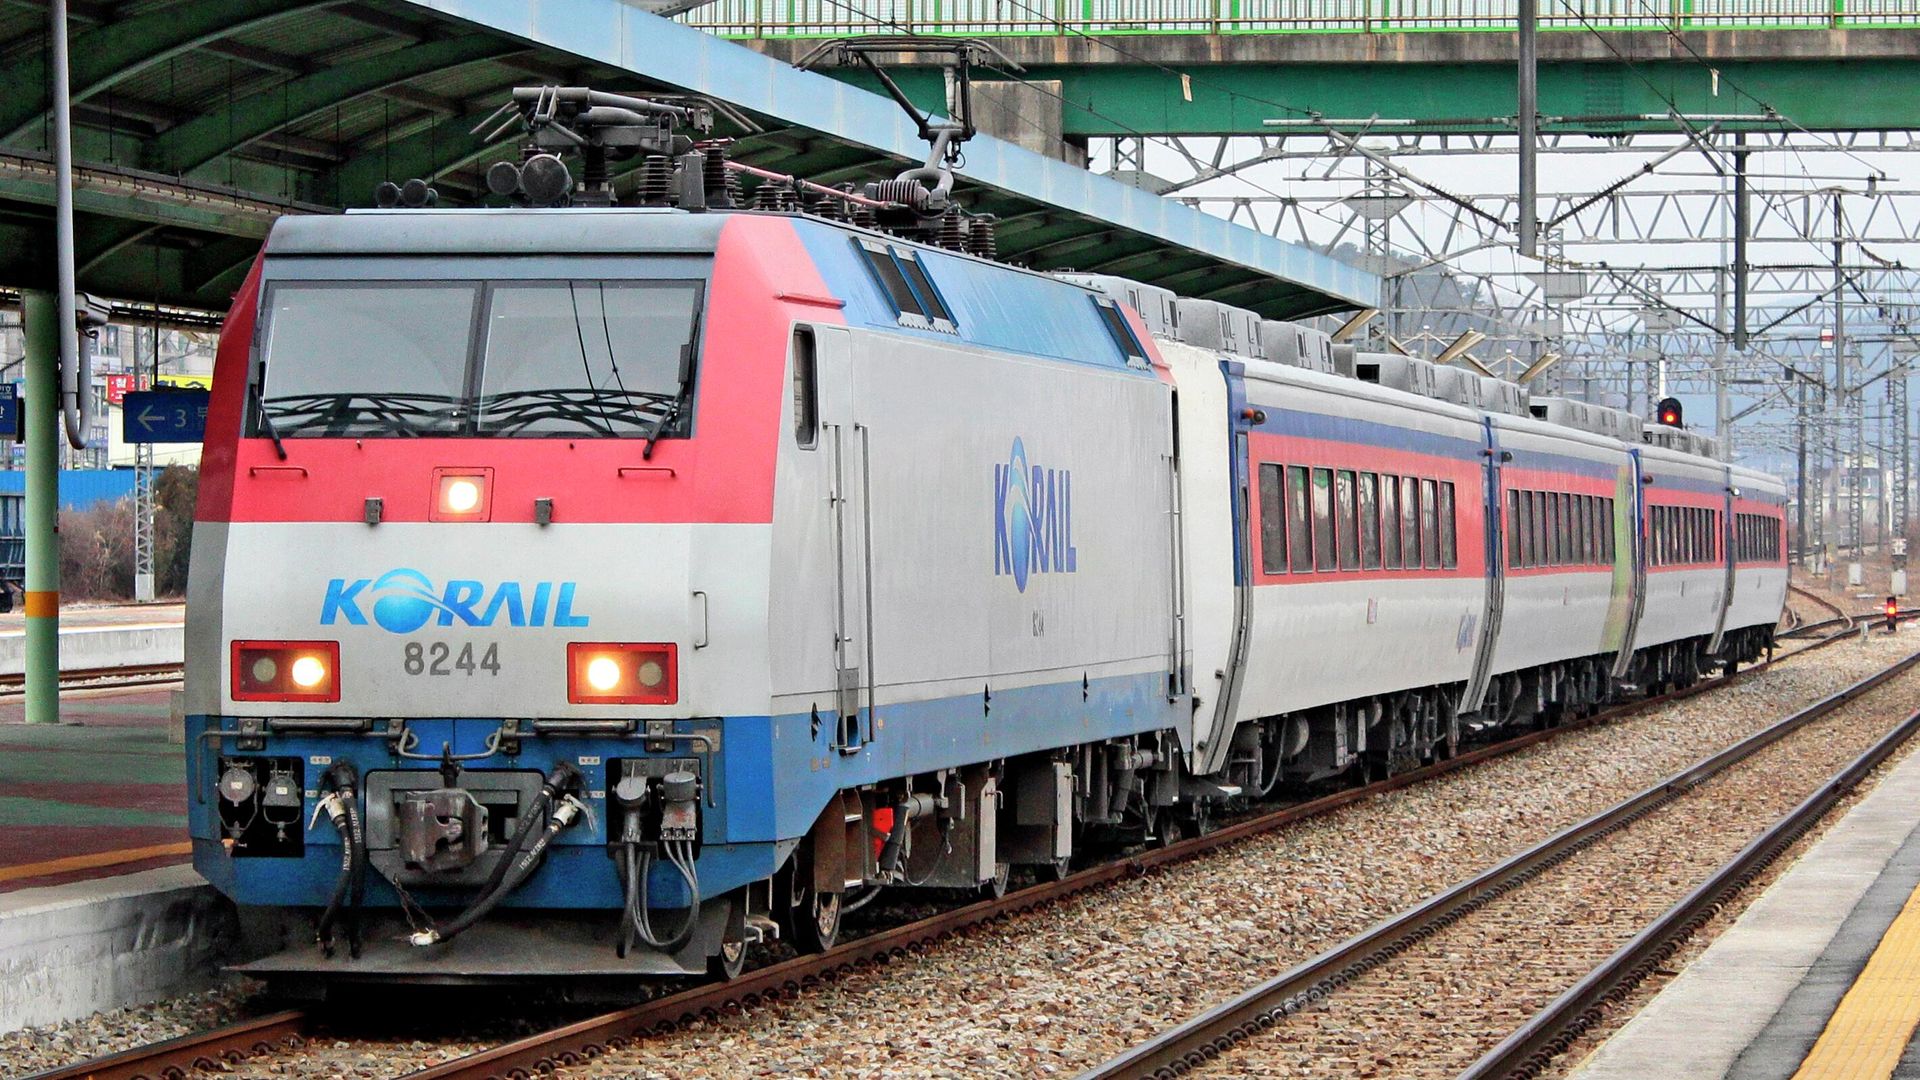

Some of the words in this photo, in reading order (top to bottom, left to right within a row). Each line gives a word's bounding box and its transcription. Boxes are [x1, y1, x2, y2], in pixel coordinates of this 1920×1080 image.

[174, 409, 186, 427] 3
[995, 436, 1076, 593] KORAIL
[320, 568, 590, 634] KORAIL
[403, 641, 501, 676] 8244
